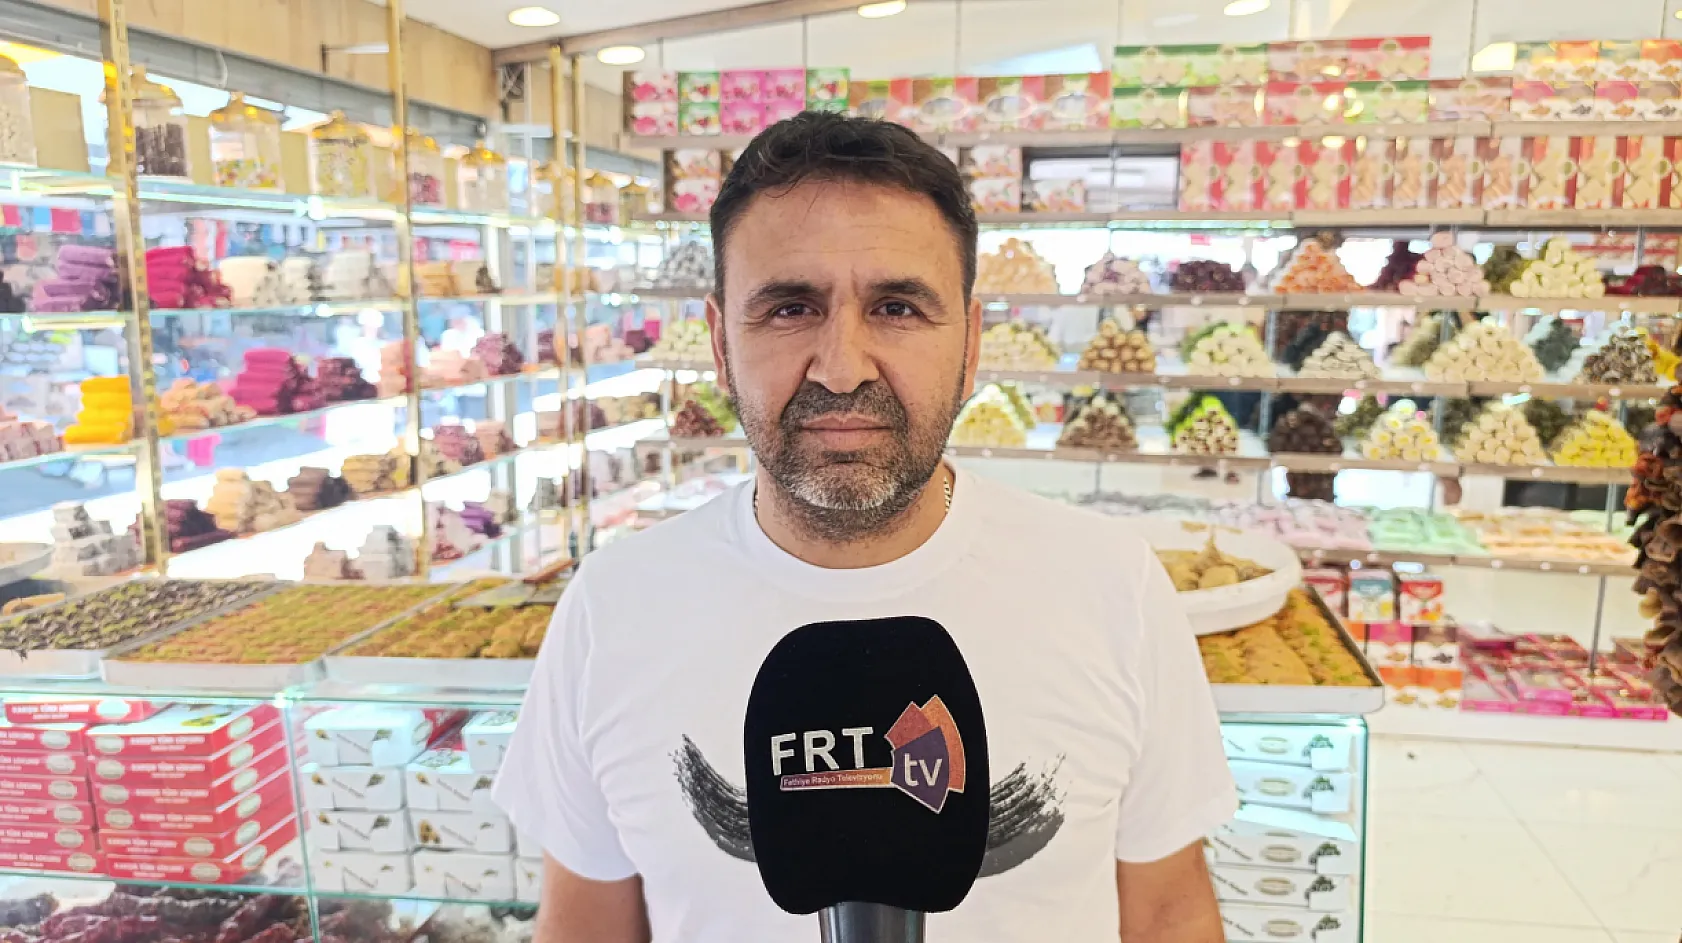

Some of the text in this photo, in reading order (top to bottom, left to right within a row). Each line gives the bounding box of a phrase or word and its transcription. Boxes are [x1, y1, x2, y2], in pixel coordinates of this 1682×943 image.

[771, 726, 874, 776] FRT
[783, 777, 810, 787] Fethiye
[811, 775, 836, 785] Radyo
[904, 752, 943, 787] tv
